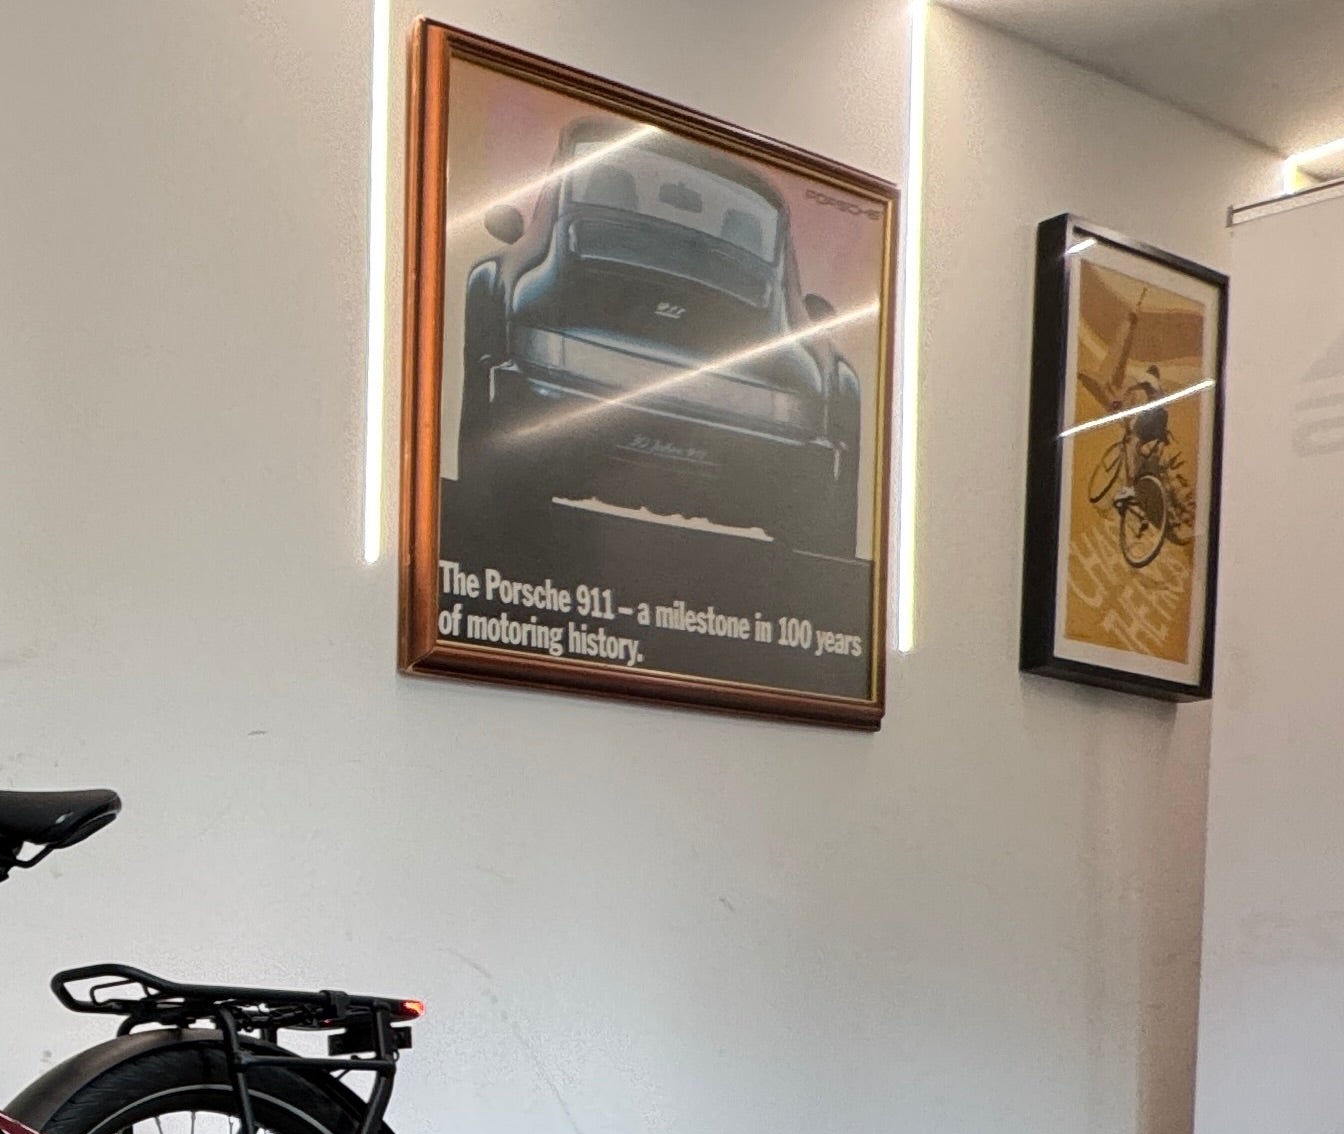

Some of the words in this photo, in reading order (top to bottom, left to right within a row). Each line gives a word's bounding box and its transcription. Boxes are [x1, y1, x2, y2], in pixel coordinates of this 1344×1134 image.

[438, 603, 463, 637] of
[467, 612, 563, 656] motoring
[568, 621, 645, 667] history.
[439, 559, 480, 598] The
[485, 568, 572, 613] Porsche
[576, 584, 615, 620] 911
[637, 602, 651, 626] a
[656, 600, 751, 640] milestone
[754, 612, 773, 643] in
[778, 616, 812, 649] 100
[815, 629, 863, 657] years
